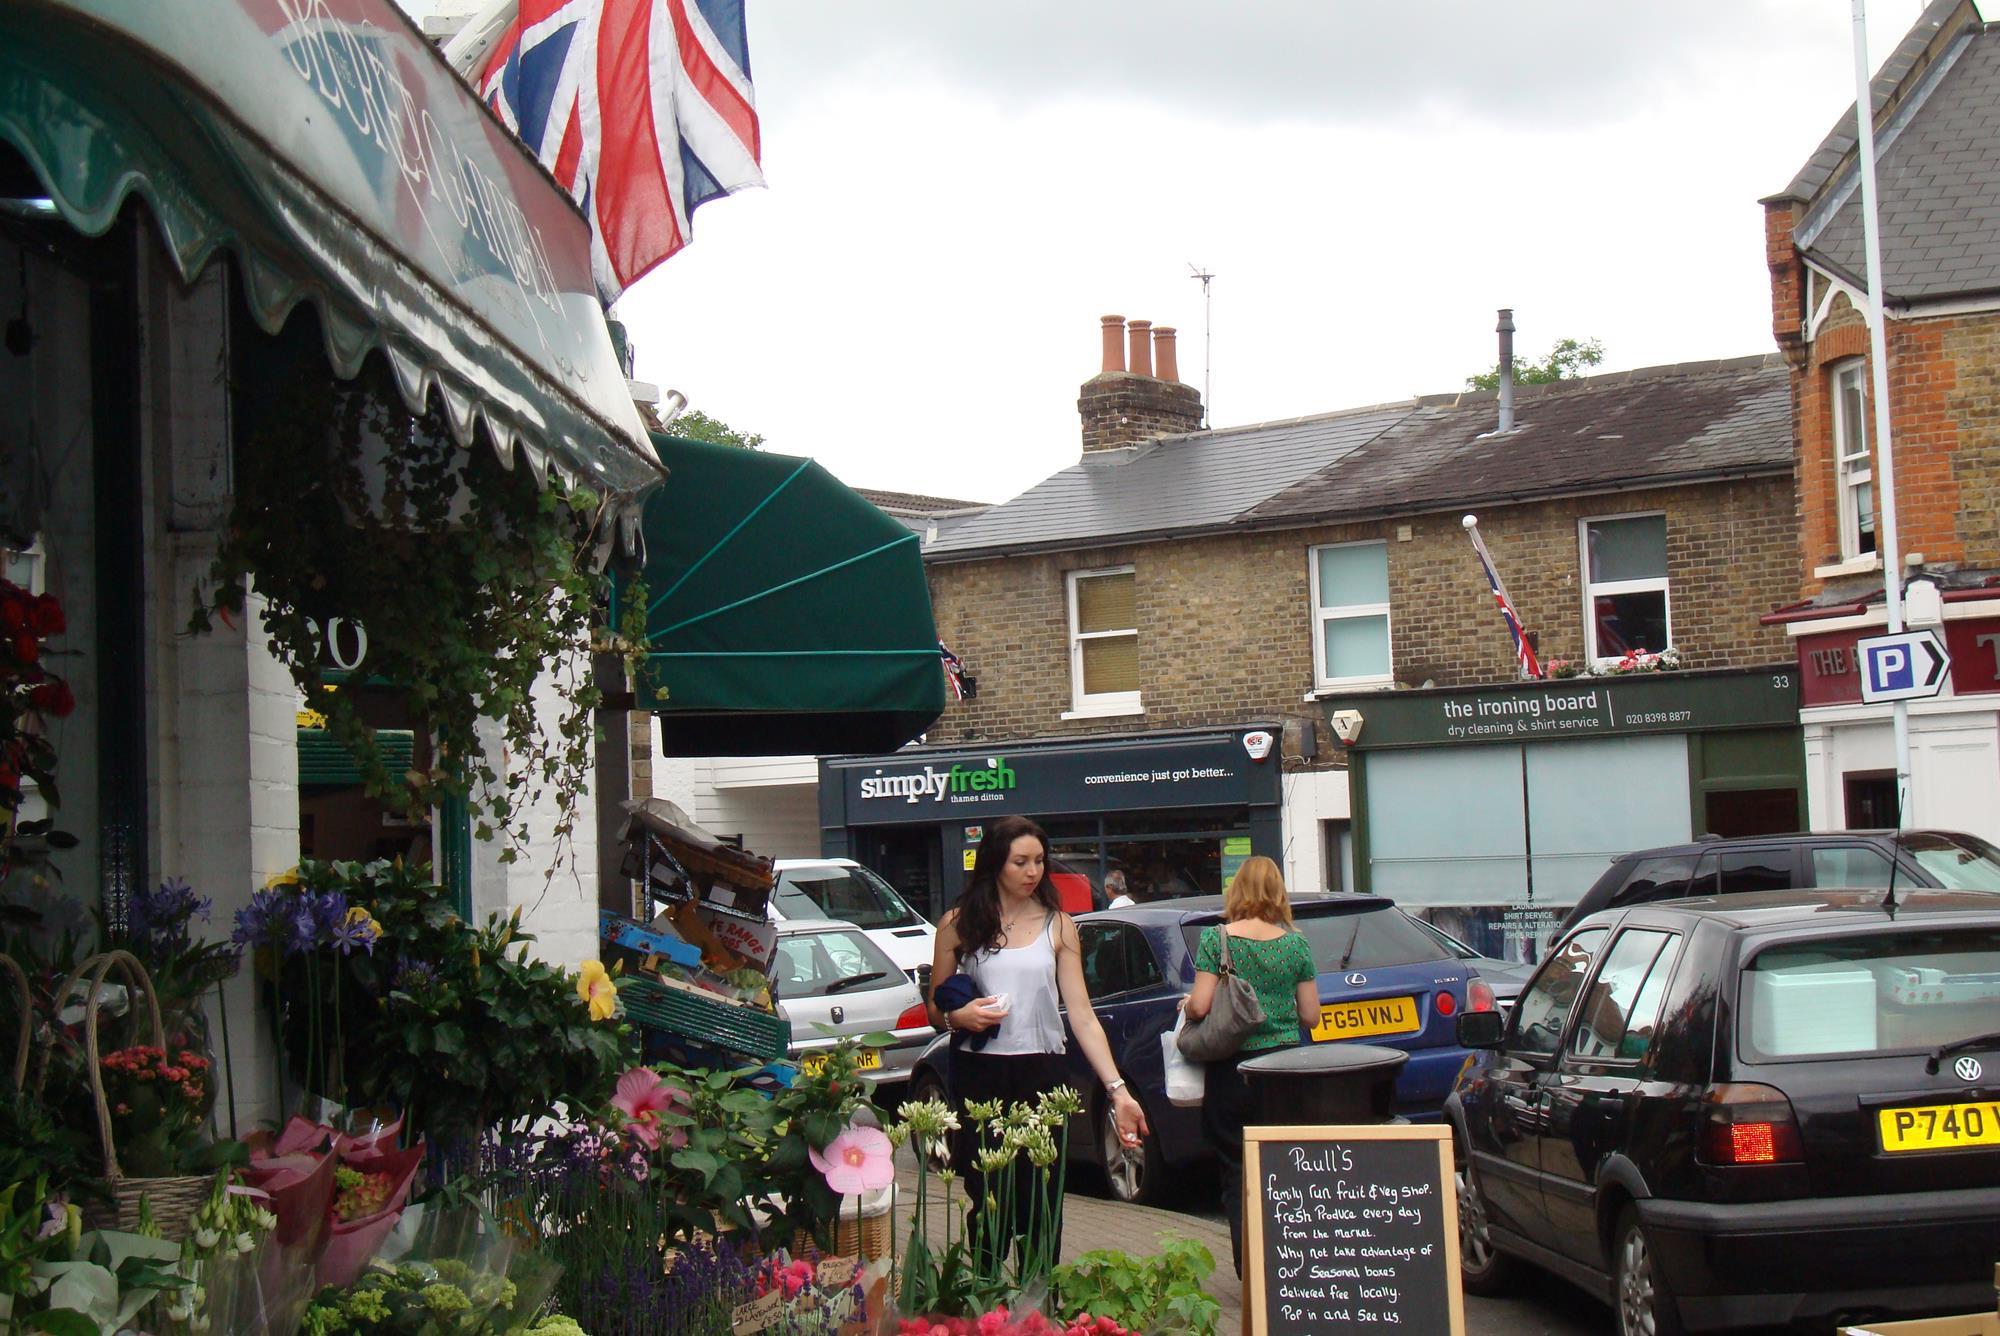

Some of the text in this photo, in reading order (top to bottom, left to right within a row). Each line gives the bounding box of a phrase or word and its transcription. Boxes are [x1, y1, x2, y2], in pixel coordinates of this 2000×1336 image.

[1809, 647, 1847, 676] THE
[1876, 649, 1905, 688] P
[1772, 675, 1790, 689] 33
[1443, 691, 1597, 718] the ironing board
[1448, 716, 1599, 737] dry cleaning & shirt service
[1626, 711, 1691, 724] 020 8398 8877
[1084, 767, 1233, 785] convenience just got better...
[951, 793, 1004, 803] thames ditton
[1504, 911, 1553, 920] SHIRT SERVICE
[1488, 922, 1517, 930] REPAIRS
[1524, 921, 1563, 929] ALTERATIO
[726, 923, 764, 955] RANGE
[1367, 1005, 1404, 1025] VNJ
[857, 1052, 874, 1068] NR
[1895, 1107, 1983, 1142] P740
[1267, 1174, 1303, 1210] family
[1309, 1184, 1331, 1199] run
[1336, 1180, 1365, 1200] fruit
[1369, 1184, 1379, 1200] &
[1379, 1186, 1398, 1204] veg
[1274, 1202, 1312, 1224] fresh
[1363, 1209, 1393, 1223] every
[1399, 1206, 1421, 1225] day
[1283, 1226, 1307, 1240] from
[1313, 1227, 1329, 1239] the
[1277, 1244, 1433, 1269] Why not take advantage of
[1365, 1266, 1395, 1277] boxes
[1280, 1285, 1401, 1304] delivered free locally.
[1281, 1304, 1302, 1321] Pop
[1308, 1309, 1317, 1320] in
[1323, 1309, 1350, 1321] and
